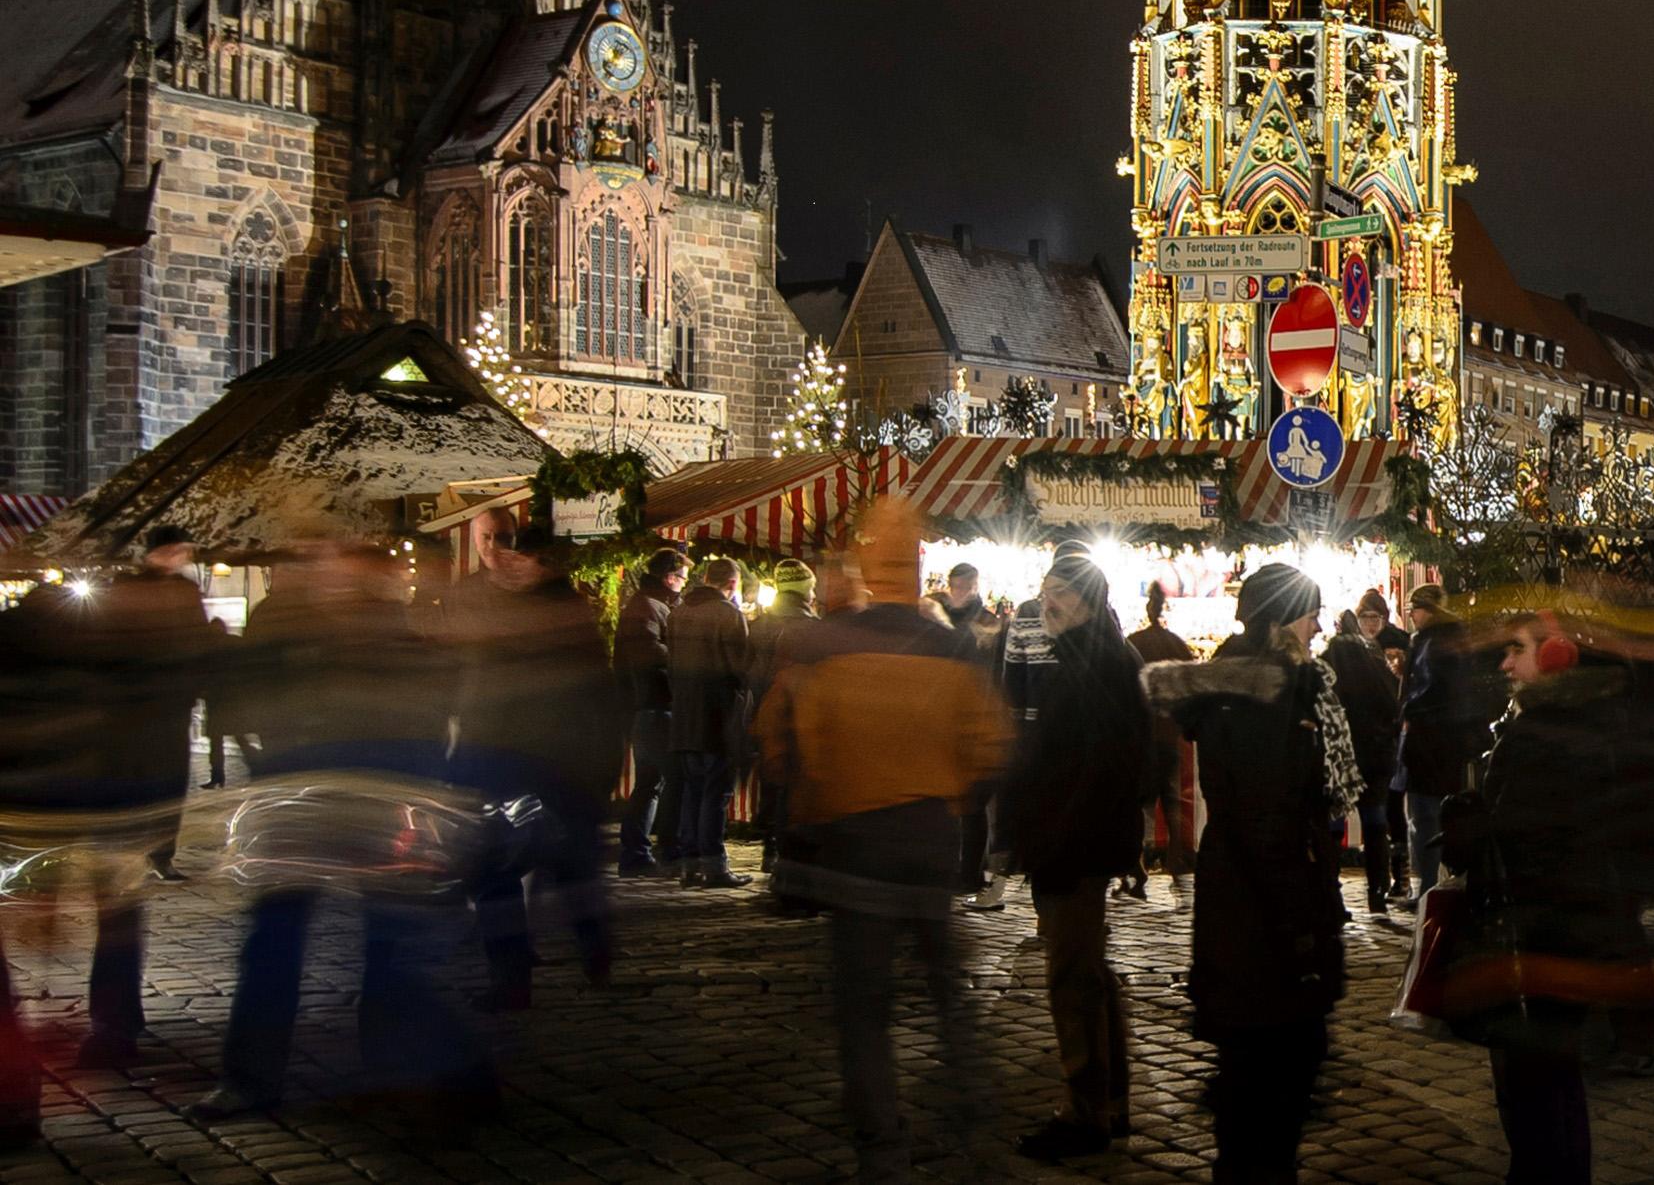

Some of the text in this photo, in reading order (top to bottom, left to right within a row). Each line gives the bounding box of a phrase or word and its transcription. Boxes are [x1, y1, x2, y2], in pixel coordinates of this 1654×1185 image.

[1186, 240, 1296, 255] Fortsetzung der Radroute
[1186, 255, 1263, 267] nach Lauf in 70m
